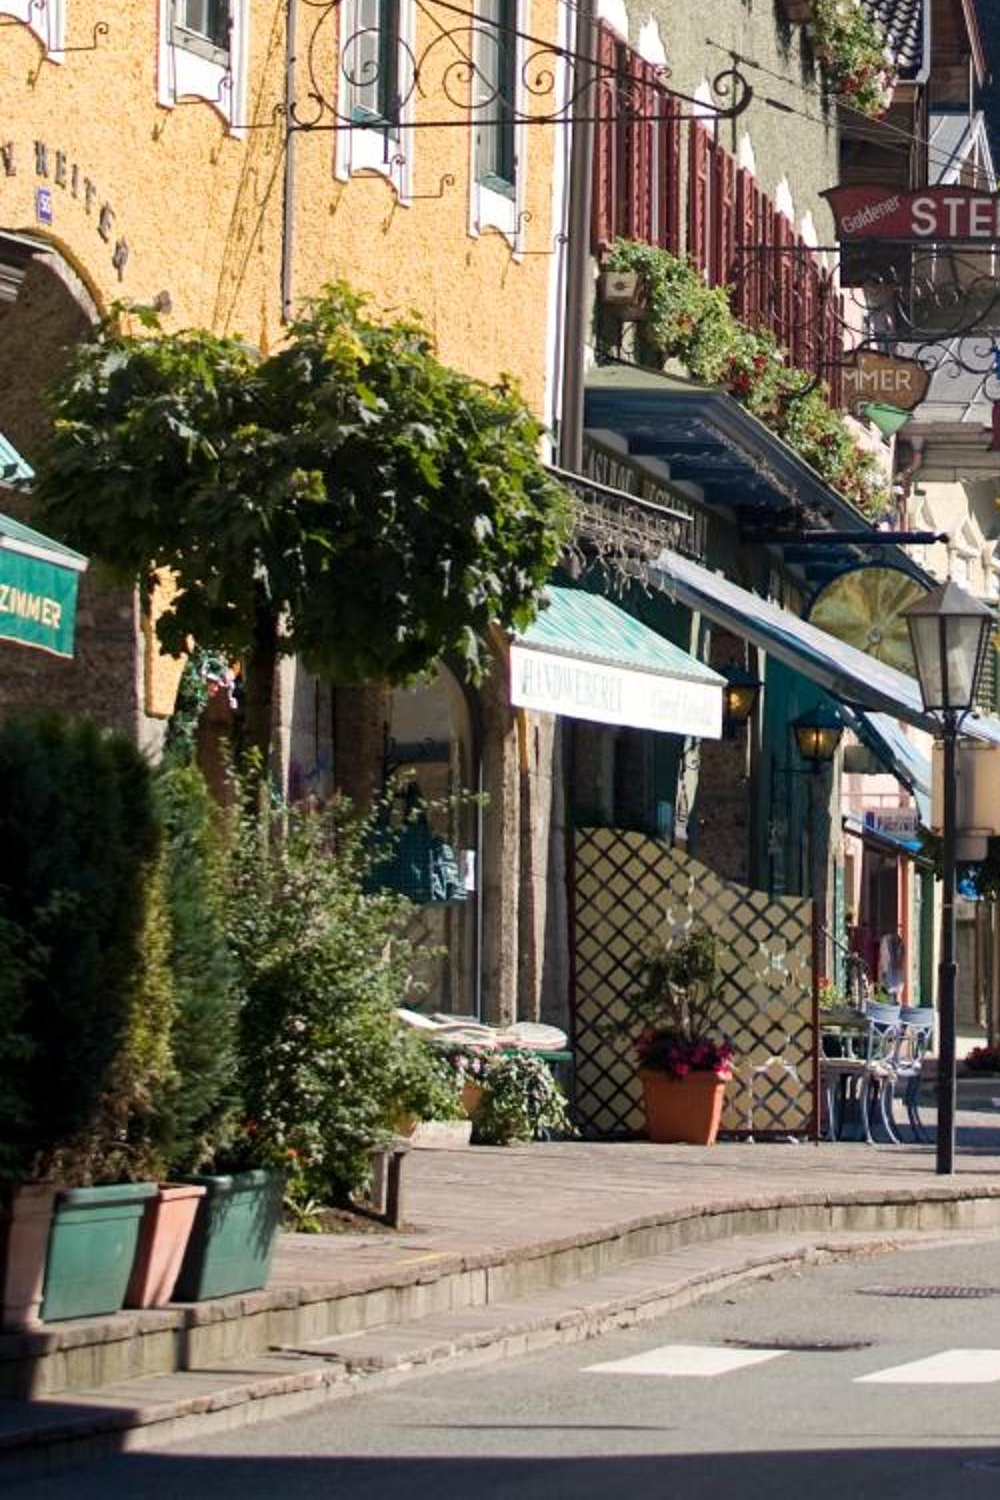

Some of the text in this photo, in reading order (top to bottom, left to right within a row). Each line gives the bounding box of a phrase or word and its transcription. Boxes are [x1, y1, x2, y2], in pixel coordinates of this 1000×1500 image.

[841, 196, 899, 234] Goldener
[841, 369, 912, 391] MMER
[0, 583, 62, 629] ZIMMER
